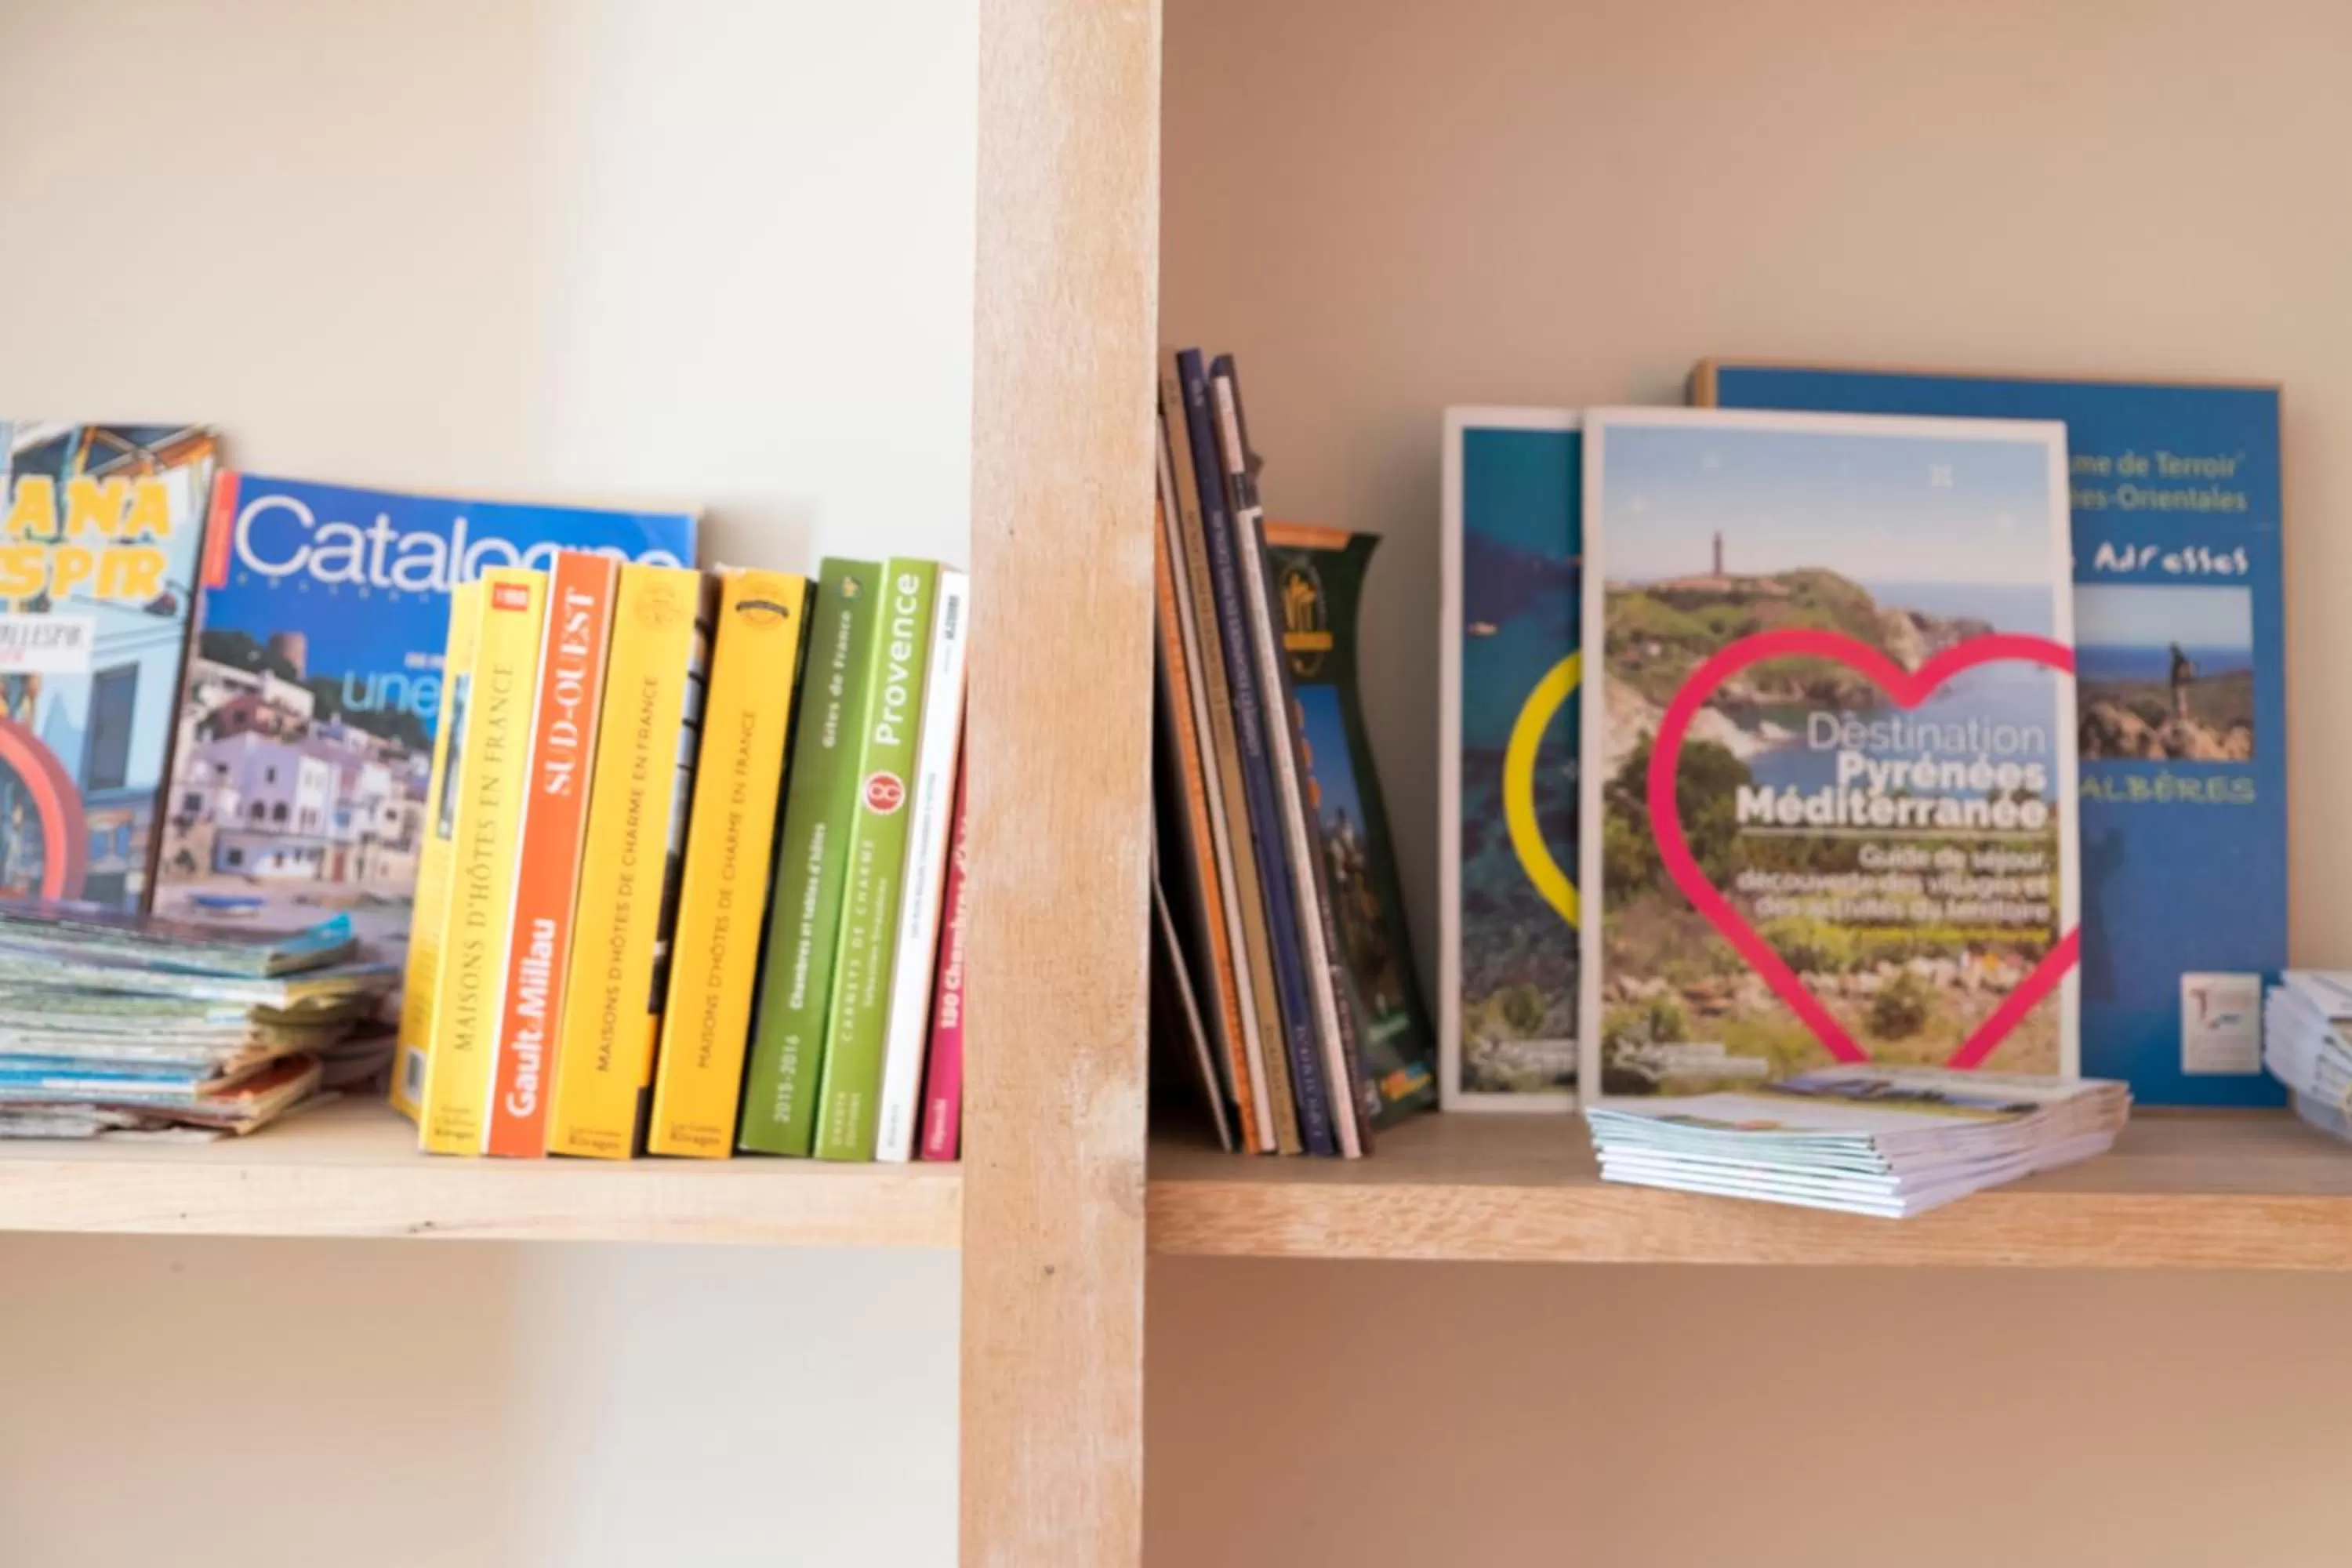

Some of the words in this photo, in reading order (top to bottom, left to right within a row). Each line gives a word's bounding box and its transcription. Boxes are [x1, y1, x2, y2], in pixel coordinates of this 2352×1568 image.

[2118, 448, 2148, 477] de
[236, 495, 684, 593] Catalo
[833, 611, 852, 669] France
[874, 573, 920, 745] Provence
[342, 670, 443, 719] une
[485, 664, 514, 764] FRANCE
[543, 587, 595, 796] SUD-OUEST
[637, 676, 658, 750] FRANCE
[829, 673, 844, 697] de
[735, 710, 756, 775] FRANCE
[1808, 710, 2046, 754] Destination
[479, 775, 499, 808] EN
[633, 758, 648, 780] EN
[732, 780, 746, 804] EN
[1836, 750, 2047, 795] Pyrénées
[622, 788, 644, 867] CHARME
[1736, 786, 2047, 827] Méditerranée
[466, 818, 494, 927] D'HÔTES
[721, 810, 745, 881] CHARME
[1858, 843, 1929, 868] Guide
[1933, 846, 1966, 869] de
[619, 871, 635, 898] DE
[718, 888, 733, 909] DE
[608, 902, 630, 981] D'HÔTES
[708, 913, 730, 988] D'HÔTES
[852, 927, 865, 948] DE
[454, 940, 485, 1051] MAISONS
[596, 989, 621, 1073] MAISONS
[698, 993, 719, 1069] MAISONS
